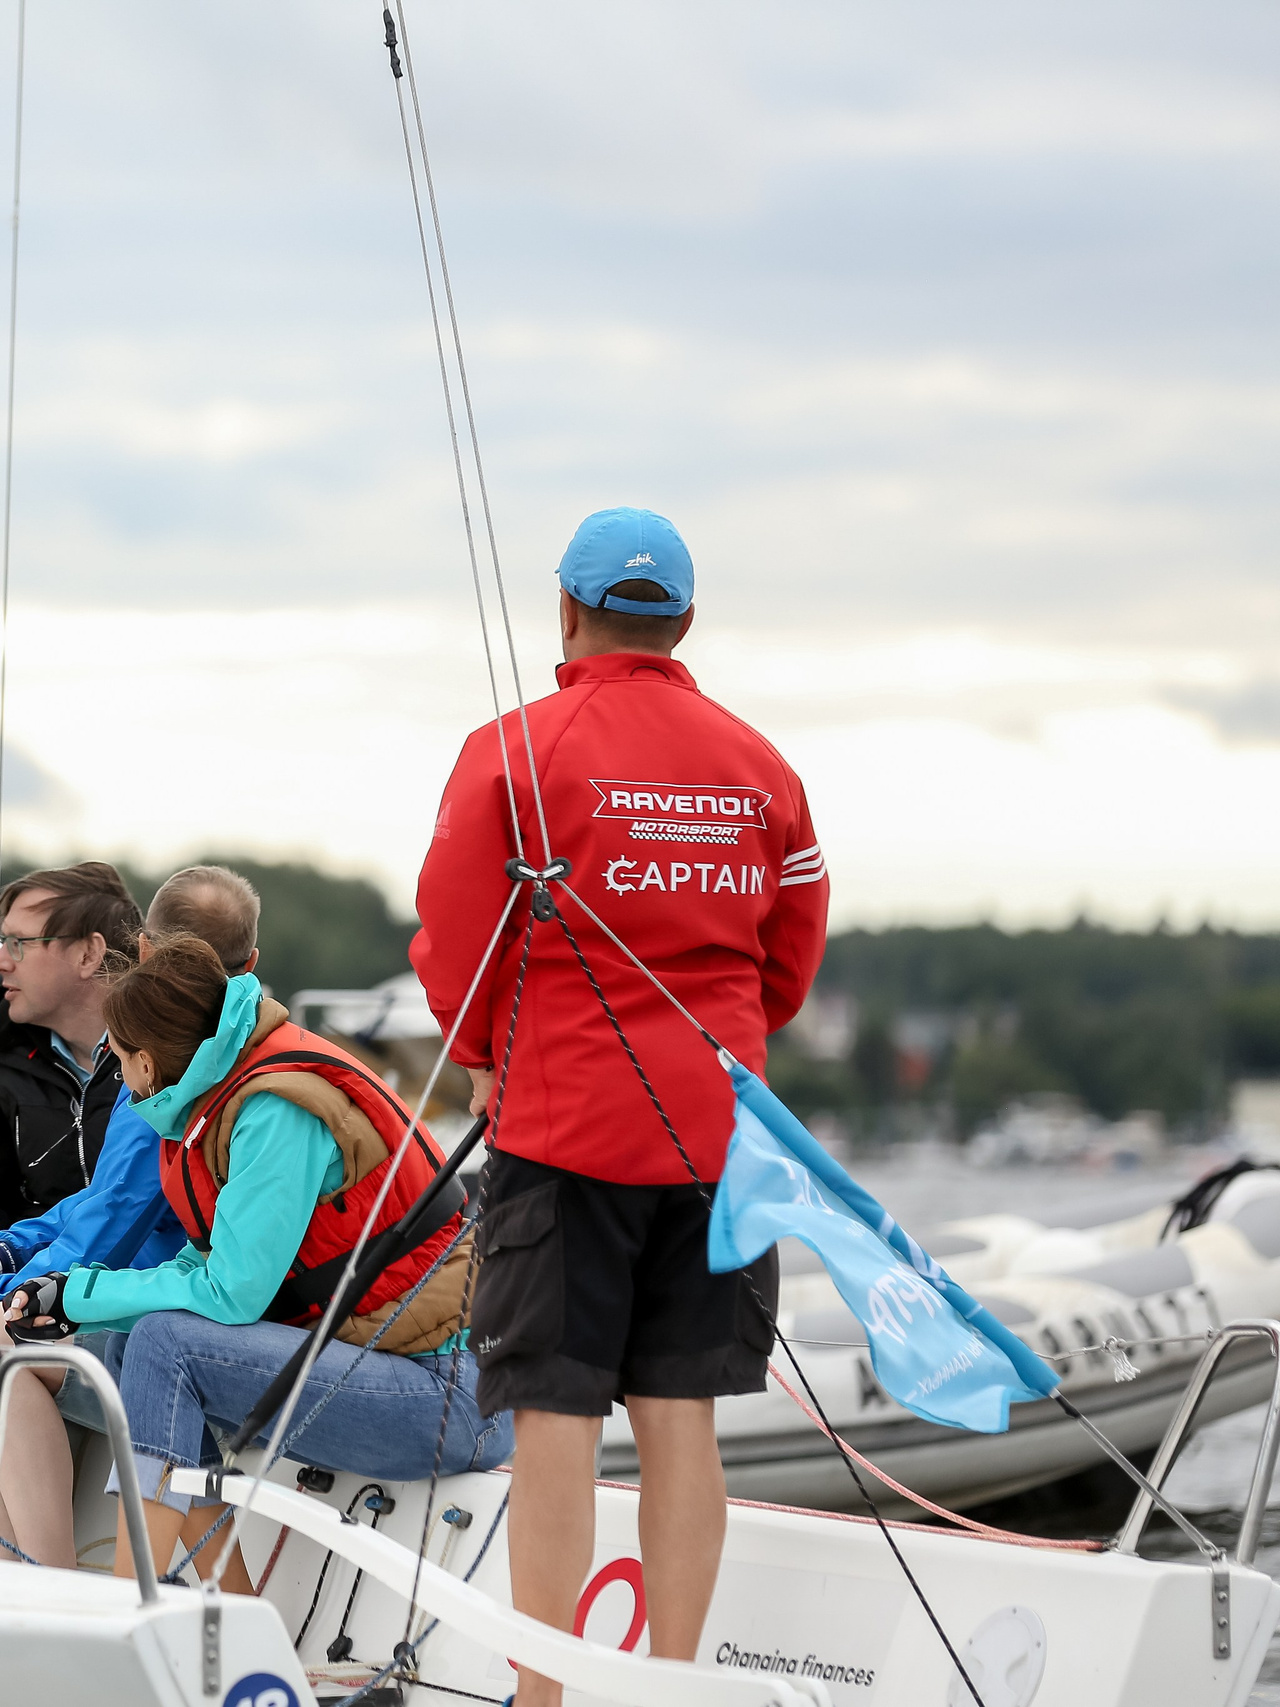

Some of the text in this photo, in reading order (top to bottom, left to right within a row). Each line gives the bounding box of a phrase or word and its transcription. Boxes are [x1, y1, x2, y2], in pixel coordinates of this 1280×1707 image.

[610, 790, 756, 817] RAVENOL
[631, 821, 744, 838] MOTORSPORT
[601, 855, 767, 897] CAPTAIN
[801, 1654, 876, 1688] finances
